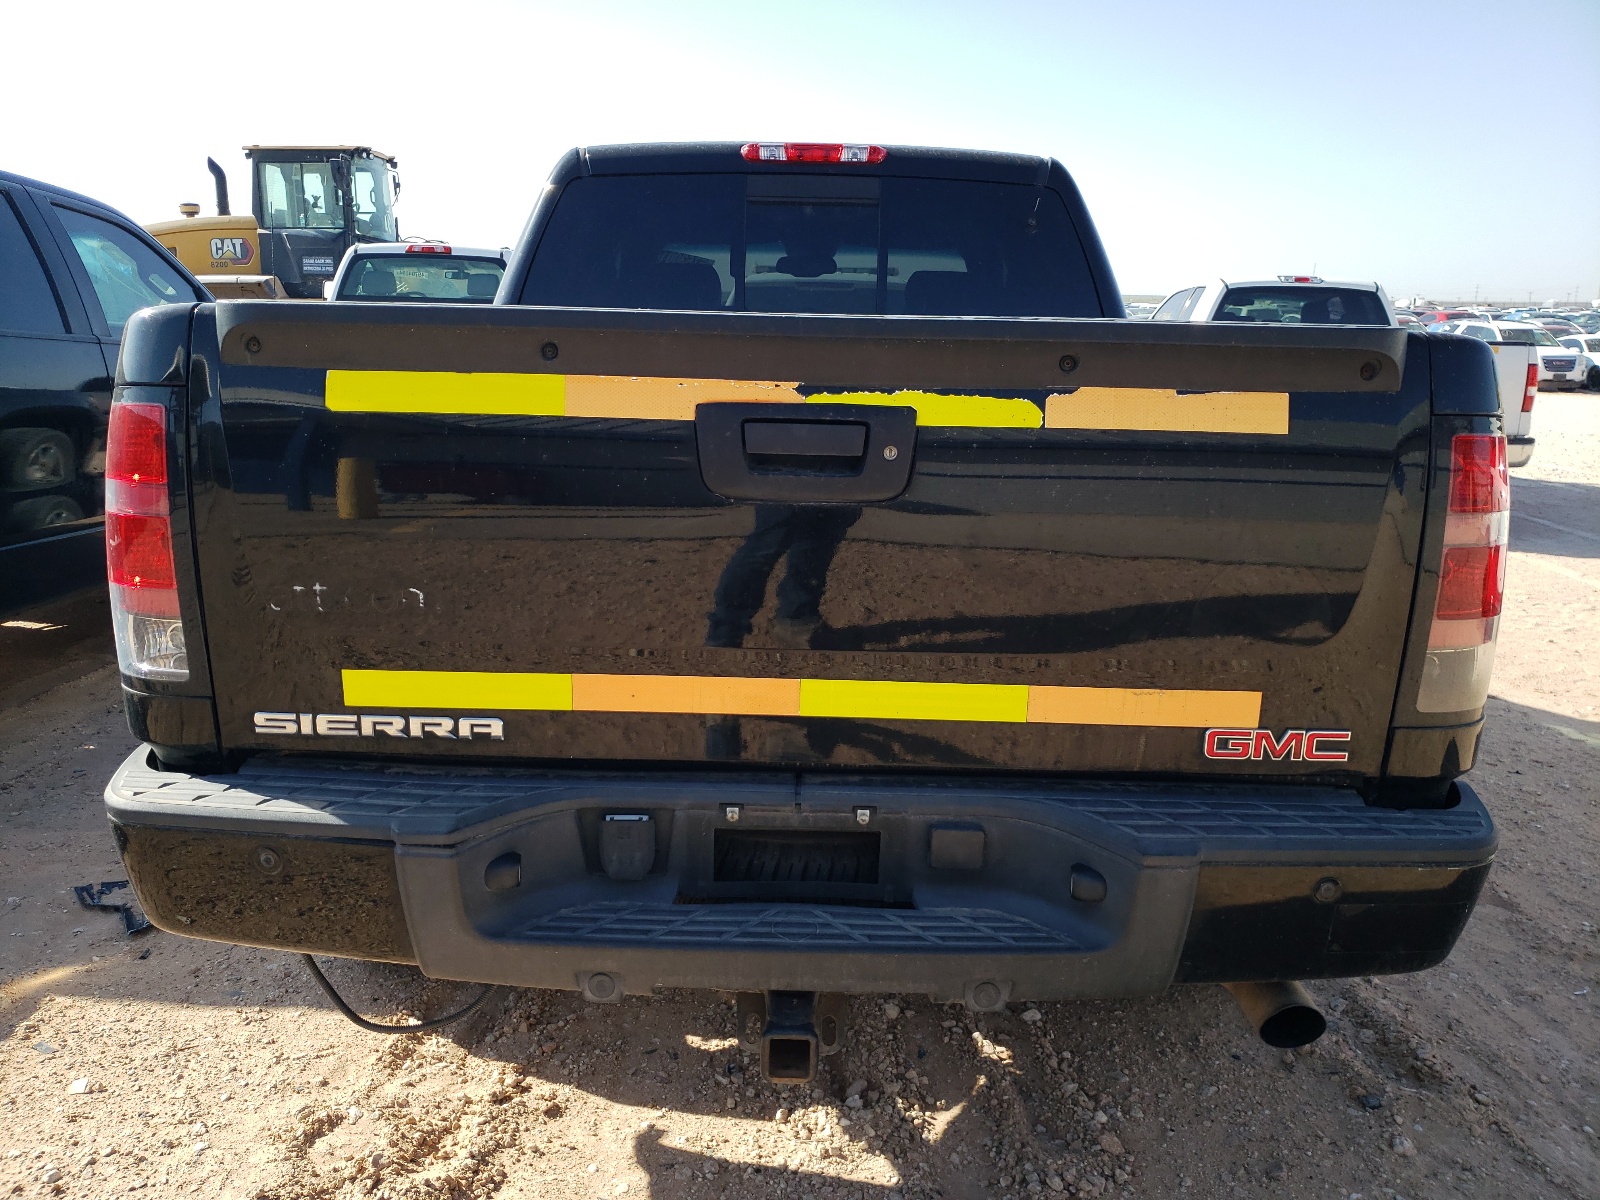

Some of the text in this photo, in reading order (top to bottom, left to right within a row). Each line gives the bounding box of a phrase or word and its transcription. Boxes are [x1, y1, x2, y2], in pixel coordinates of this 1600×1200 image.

[210, 238, 244, 260] CAT
[253, 711, 504, 741] SIERRA
[1204, 728, 1352, 762] GMC
